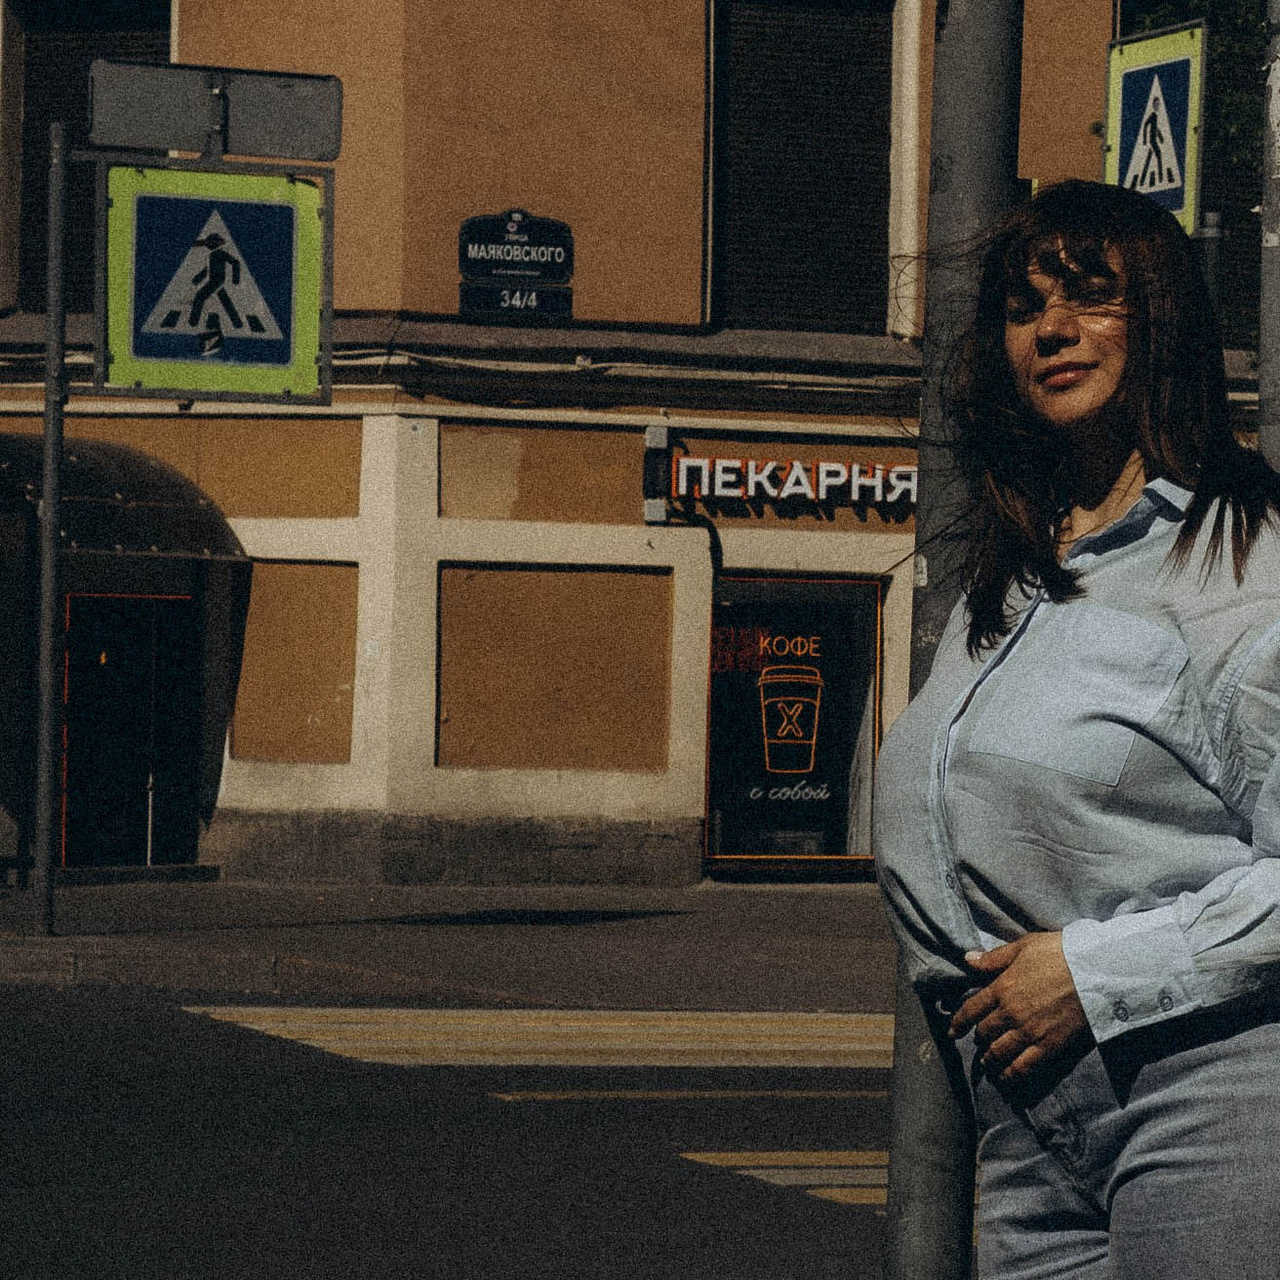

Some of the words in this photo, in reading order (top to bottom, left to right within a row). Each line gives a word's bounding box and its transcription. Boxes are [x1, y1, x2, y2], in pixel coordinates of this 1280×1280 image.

[467, 243, 565, 262] МАЯКОВСКОГО
[500, 289, 537, 309] 34/4
[675, 455, 918, 504] ПЕКАРНЯ
[759, 635, 822, 657] КОФЕ
[768, 780, 831, 801] собой
